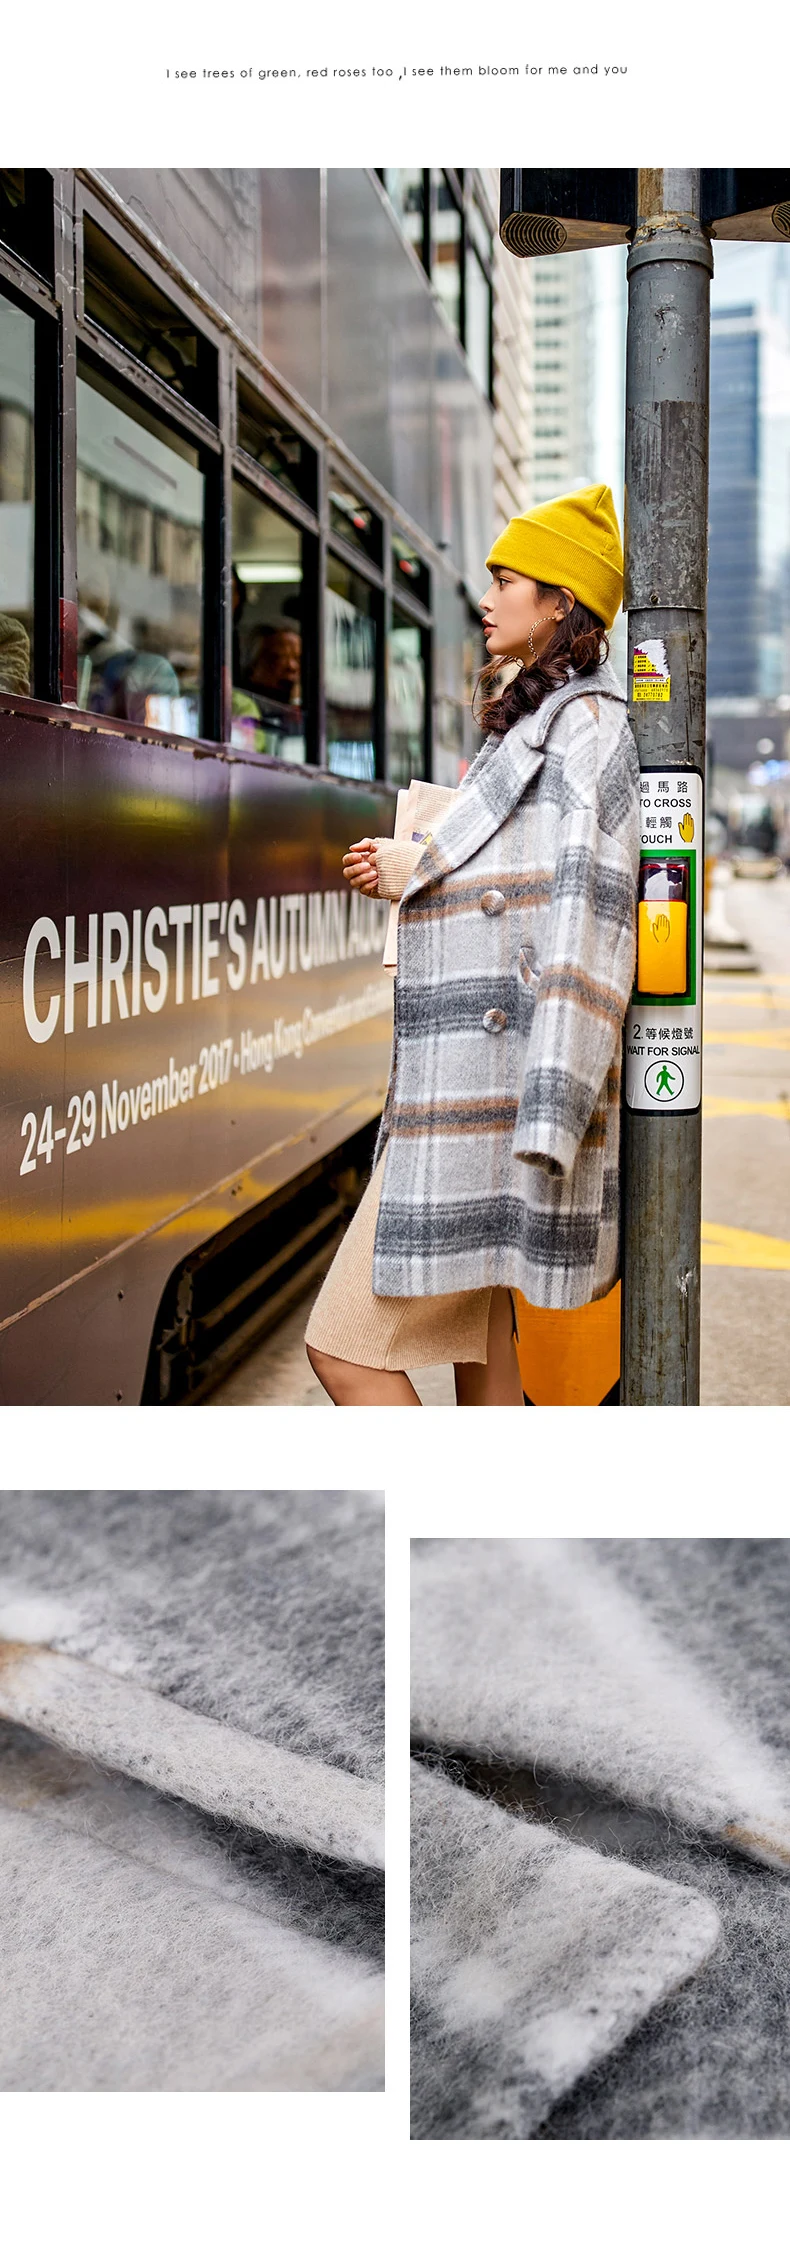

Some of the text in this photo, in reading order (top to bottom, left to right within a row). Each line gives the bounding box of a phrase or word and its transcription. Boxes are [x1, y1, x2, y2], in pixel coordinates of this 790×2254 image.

[654, 798, 692, 808] CROSS
[640, 834, 673, 844] OUCH
[22, 898, 247, 1044] CHRISTIE'S
[250, 889, 349, 985] AUTUMN
[626, 1045, 700, 1056] WAIT FOR SIGNAL
[101, 1057, 199, 1139] November
[198, 1037, 234, 1095] 2017
[240, 1029, 274, 1075] Hong
[274, 1017, 304, 1060] Kong
